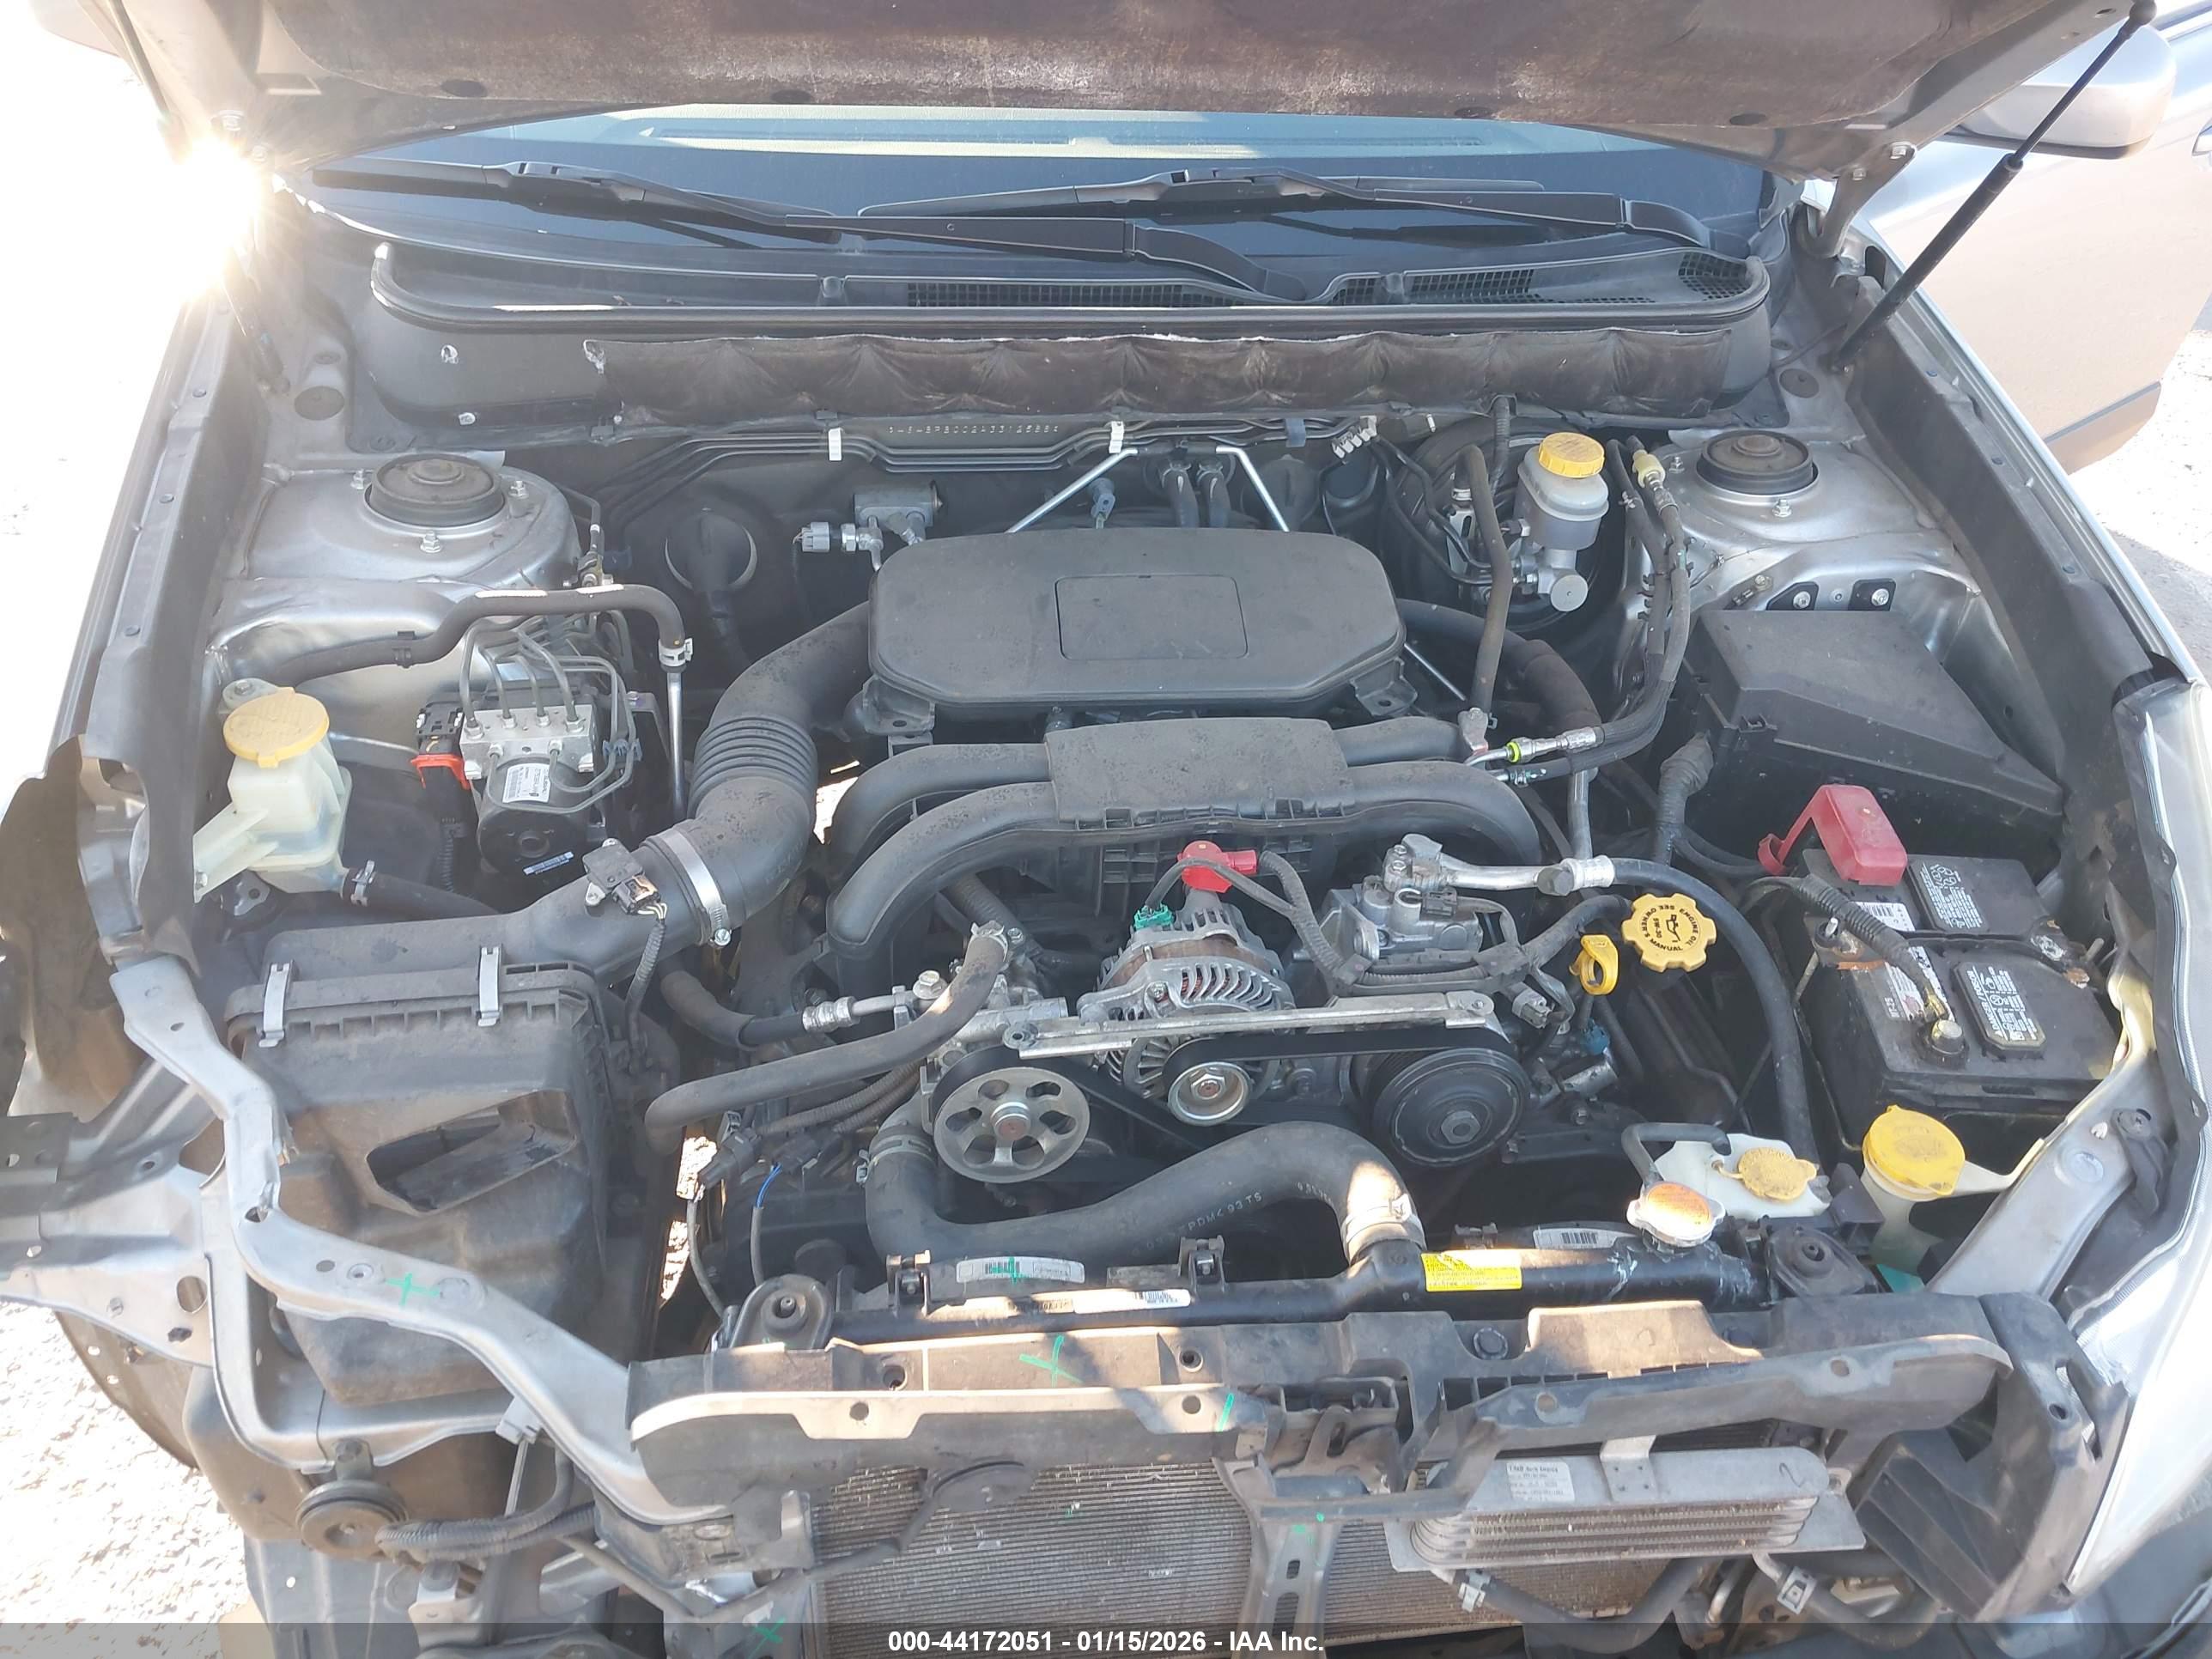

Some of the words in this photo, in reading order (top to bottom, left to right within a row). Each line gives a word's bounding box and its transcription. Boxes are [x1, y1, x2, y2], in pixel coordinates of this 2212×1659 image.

[1653, 917, 1663, 939] 5W-30
[1679, 908, 1698, 934] ENGINE
[1650, 938, 1683, 951] MANUAL
[1686, 935, 1697, 946] OIL
